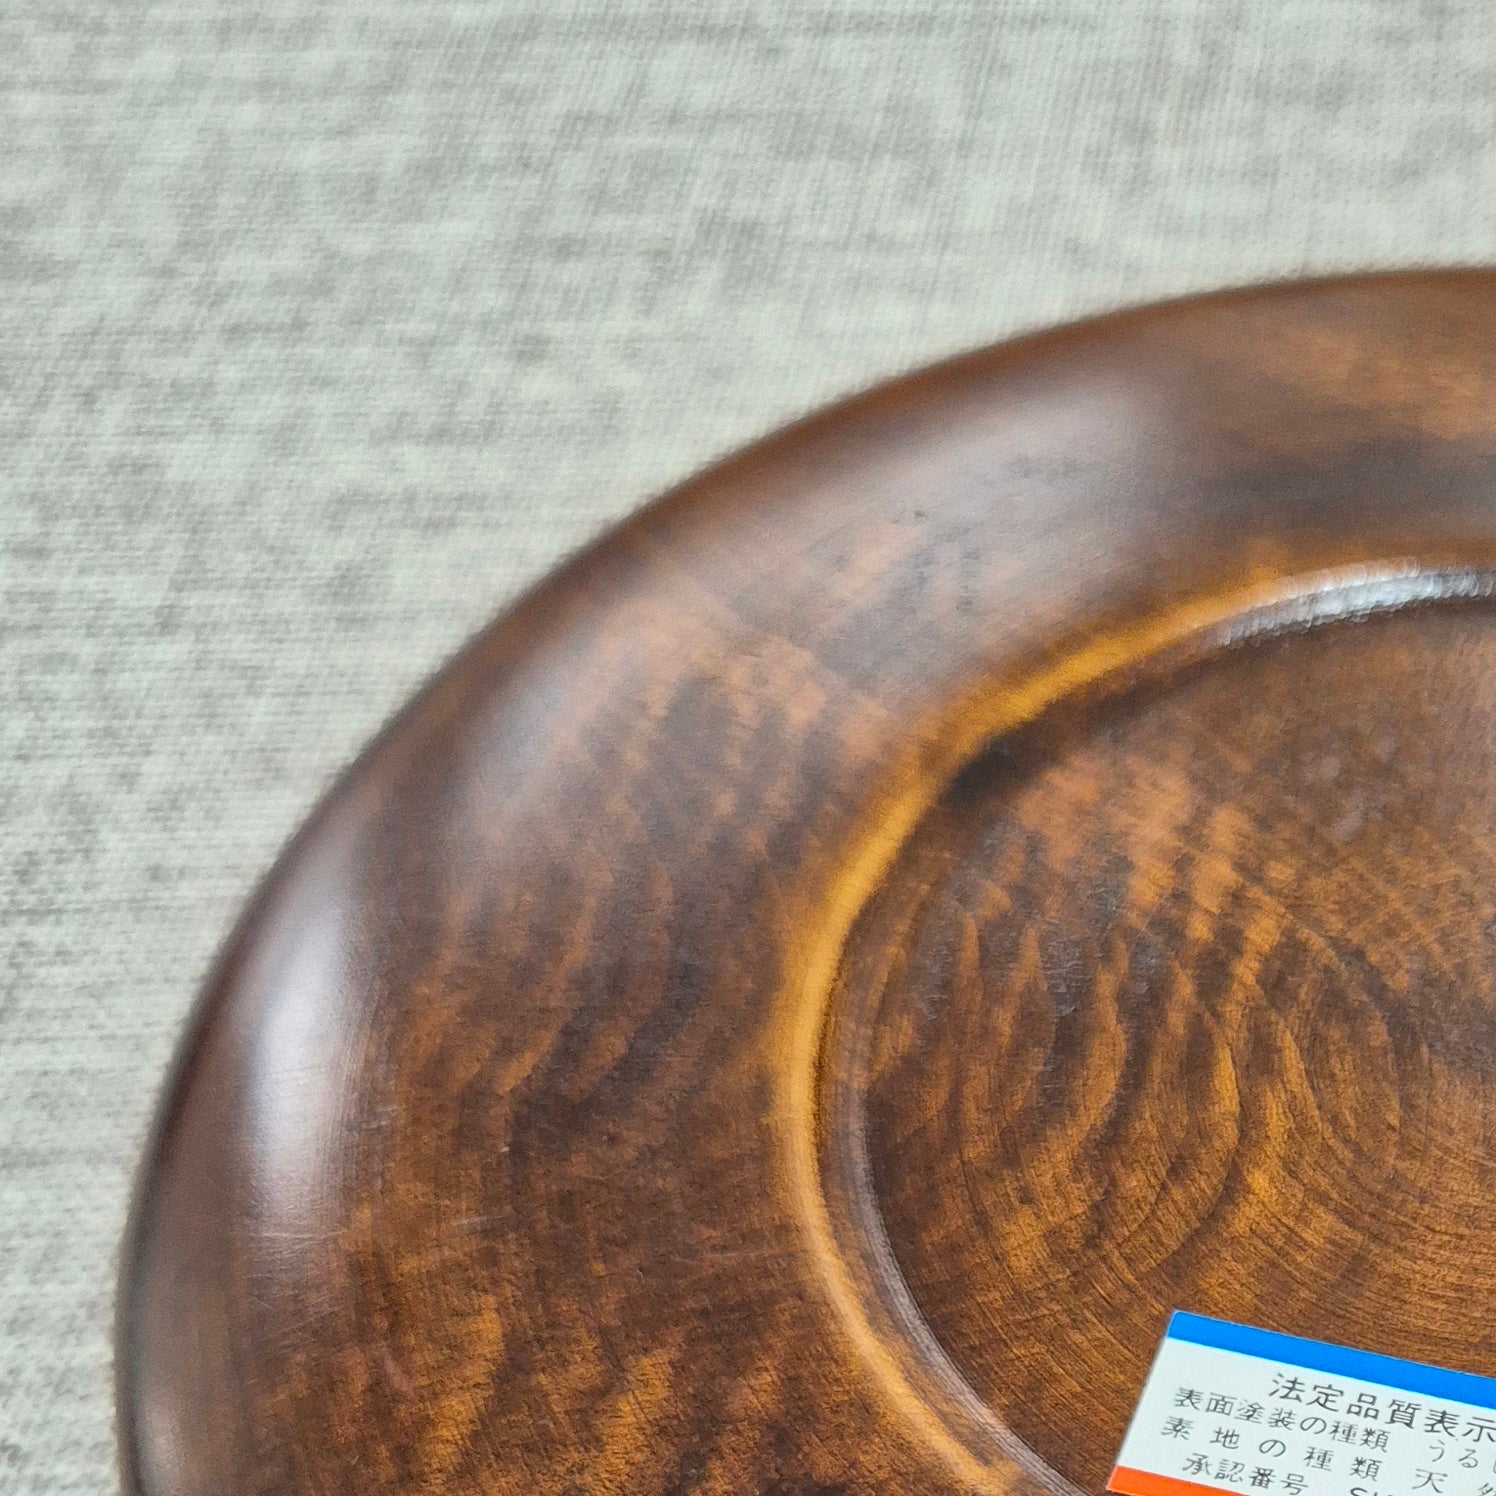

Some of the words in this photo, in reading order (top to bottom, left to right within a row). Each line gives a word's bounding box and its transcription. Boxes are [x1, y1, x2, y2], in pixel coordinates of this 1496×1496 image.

[1173, 1387, 1389, 1454] 表面塗装の種類
[1182, 1452, 1309, 1496] 承認番号
